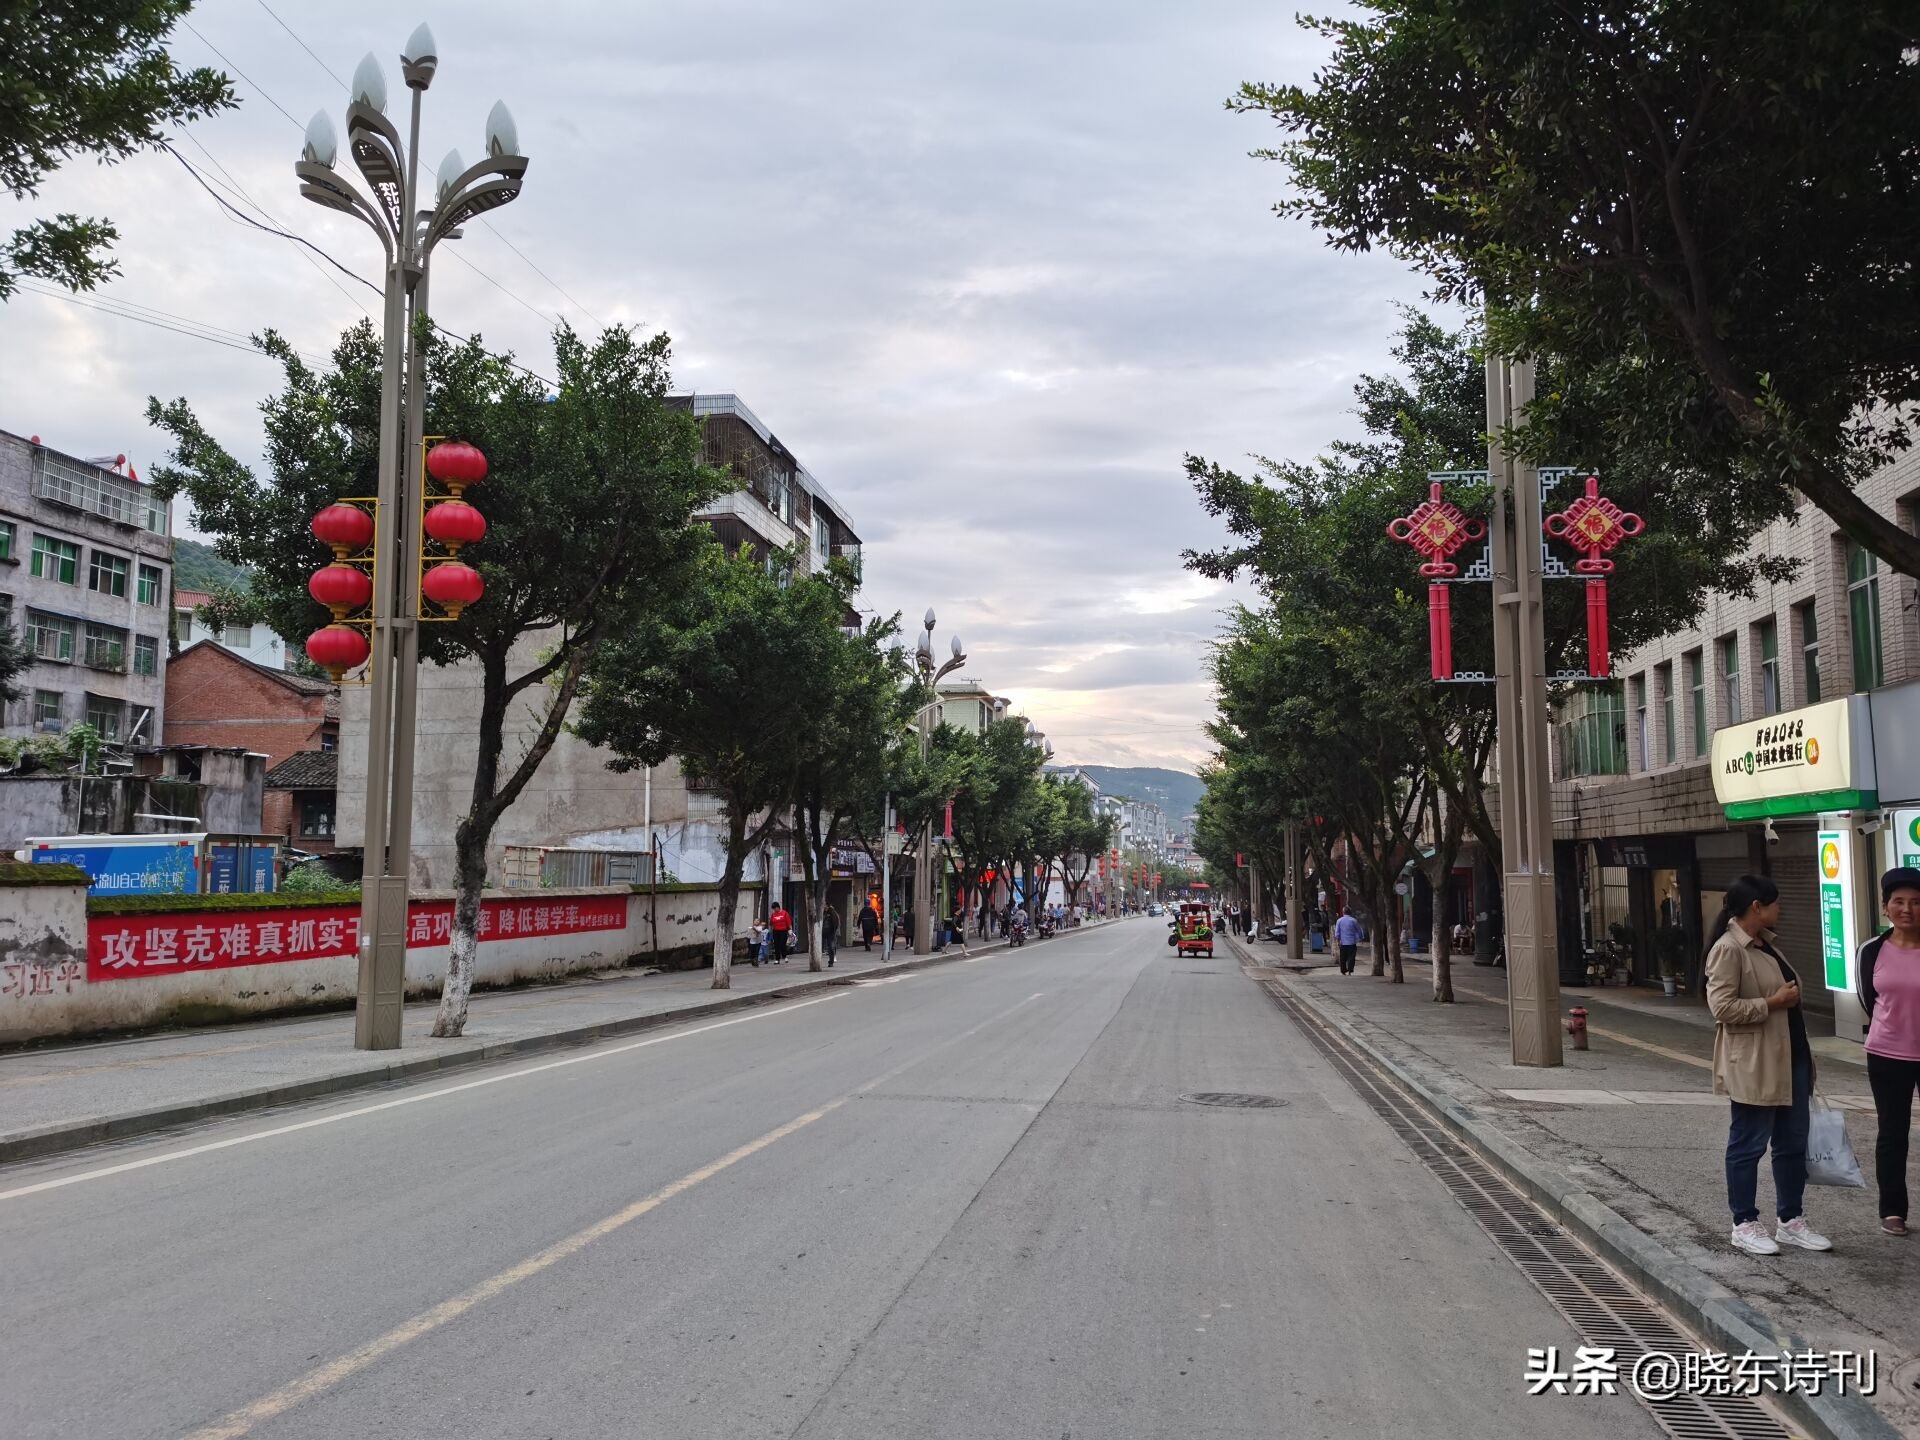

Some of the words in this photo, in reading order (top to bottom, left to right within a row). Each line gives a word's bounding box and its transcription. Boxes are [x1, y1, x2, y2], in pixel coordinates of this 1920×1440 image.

[1583, 513, 1605, 536] 福
[1725, 757, 1744, 774] ABC
[1755, 742, 1803, 768] 中国农业银行
[3, 959, 81, 999] 习近平
